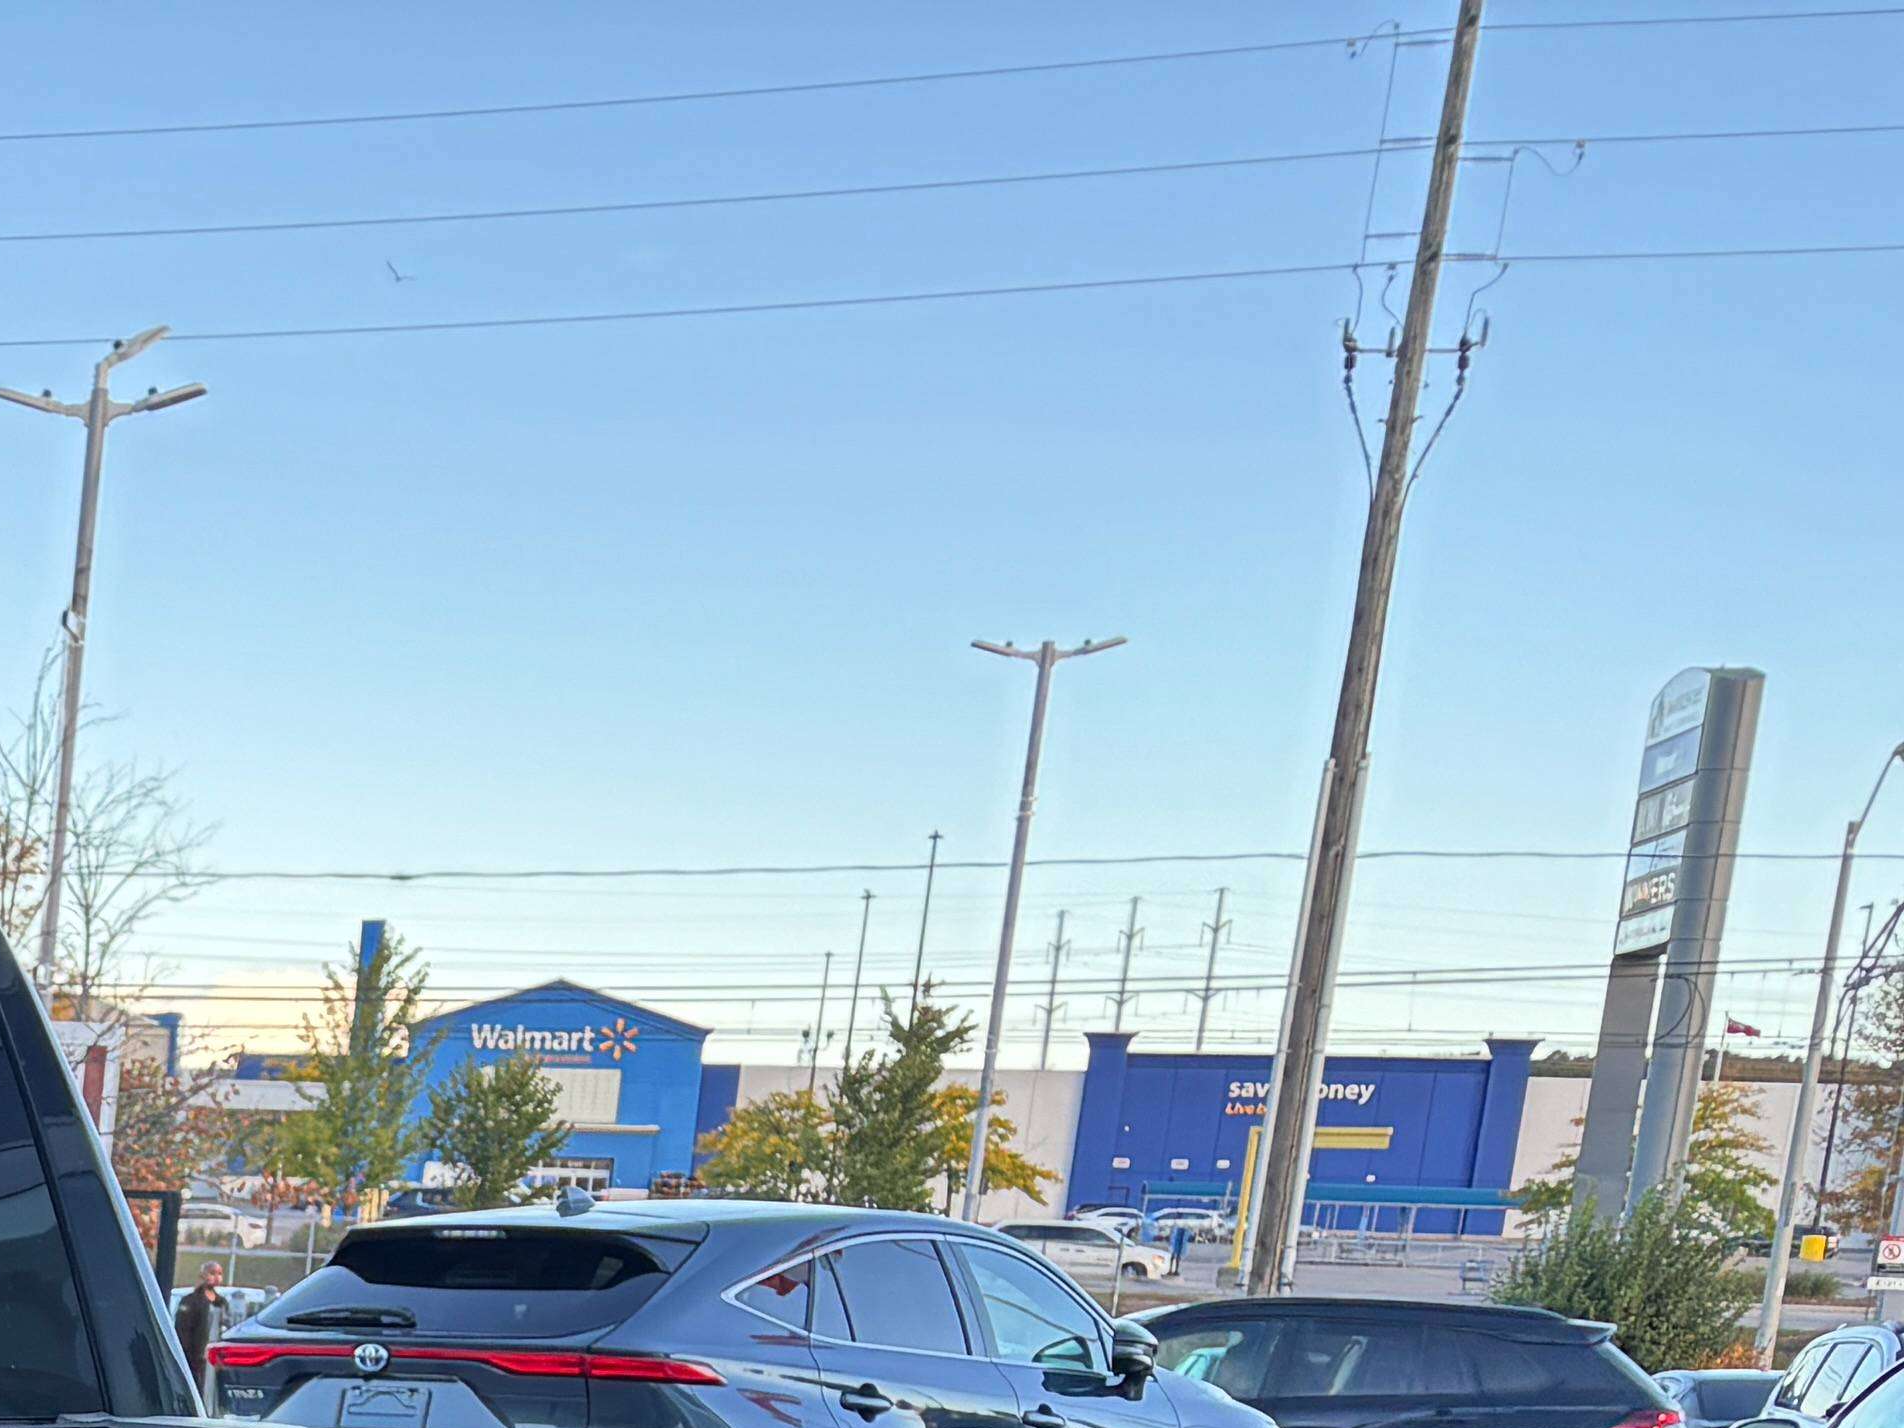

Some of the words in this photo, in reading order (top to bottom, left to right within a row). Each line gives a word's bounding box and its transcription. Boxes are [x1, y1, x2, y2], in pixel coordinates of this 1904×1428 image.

[471, 1023, 595, 1051] Walmart
[1228, 1082, 1271, 1098] sav
[1318, 1083, 1376, 1105] oney
